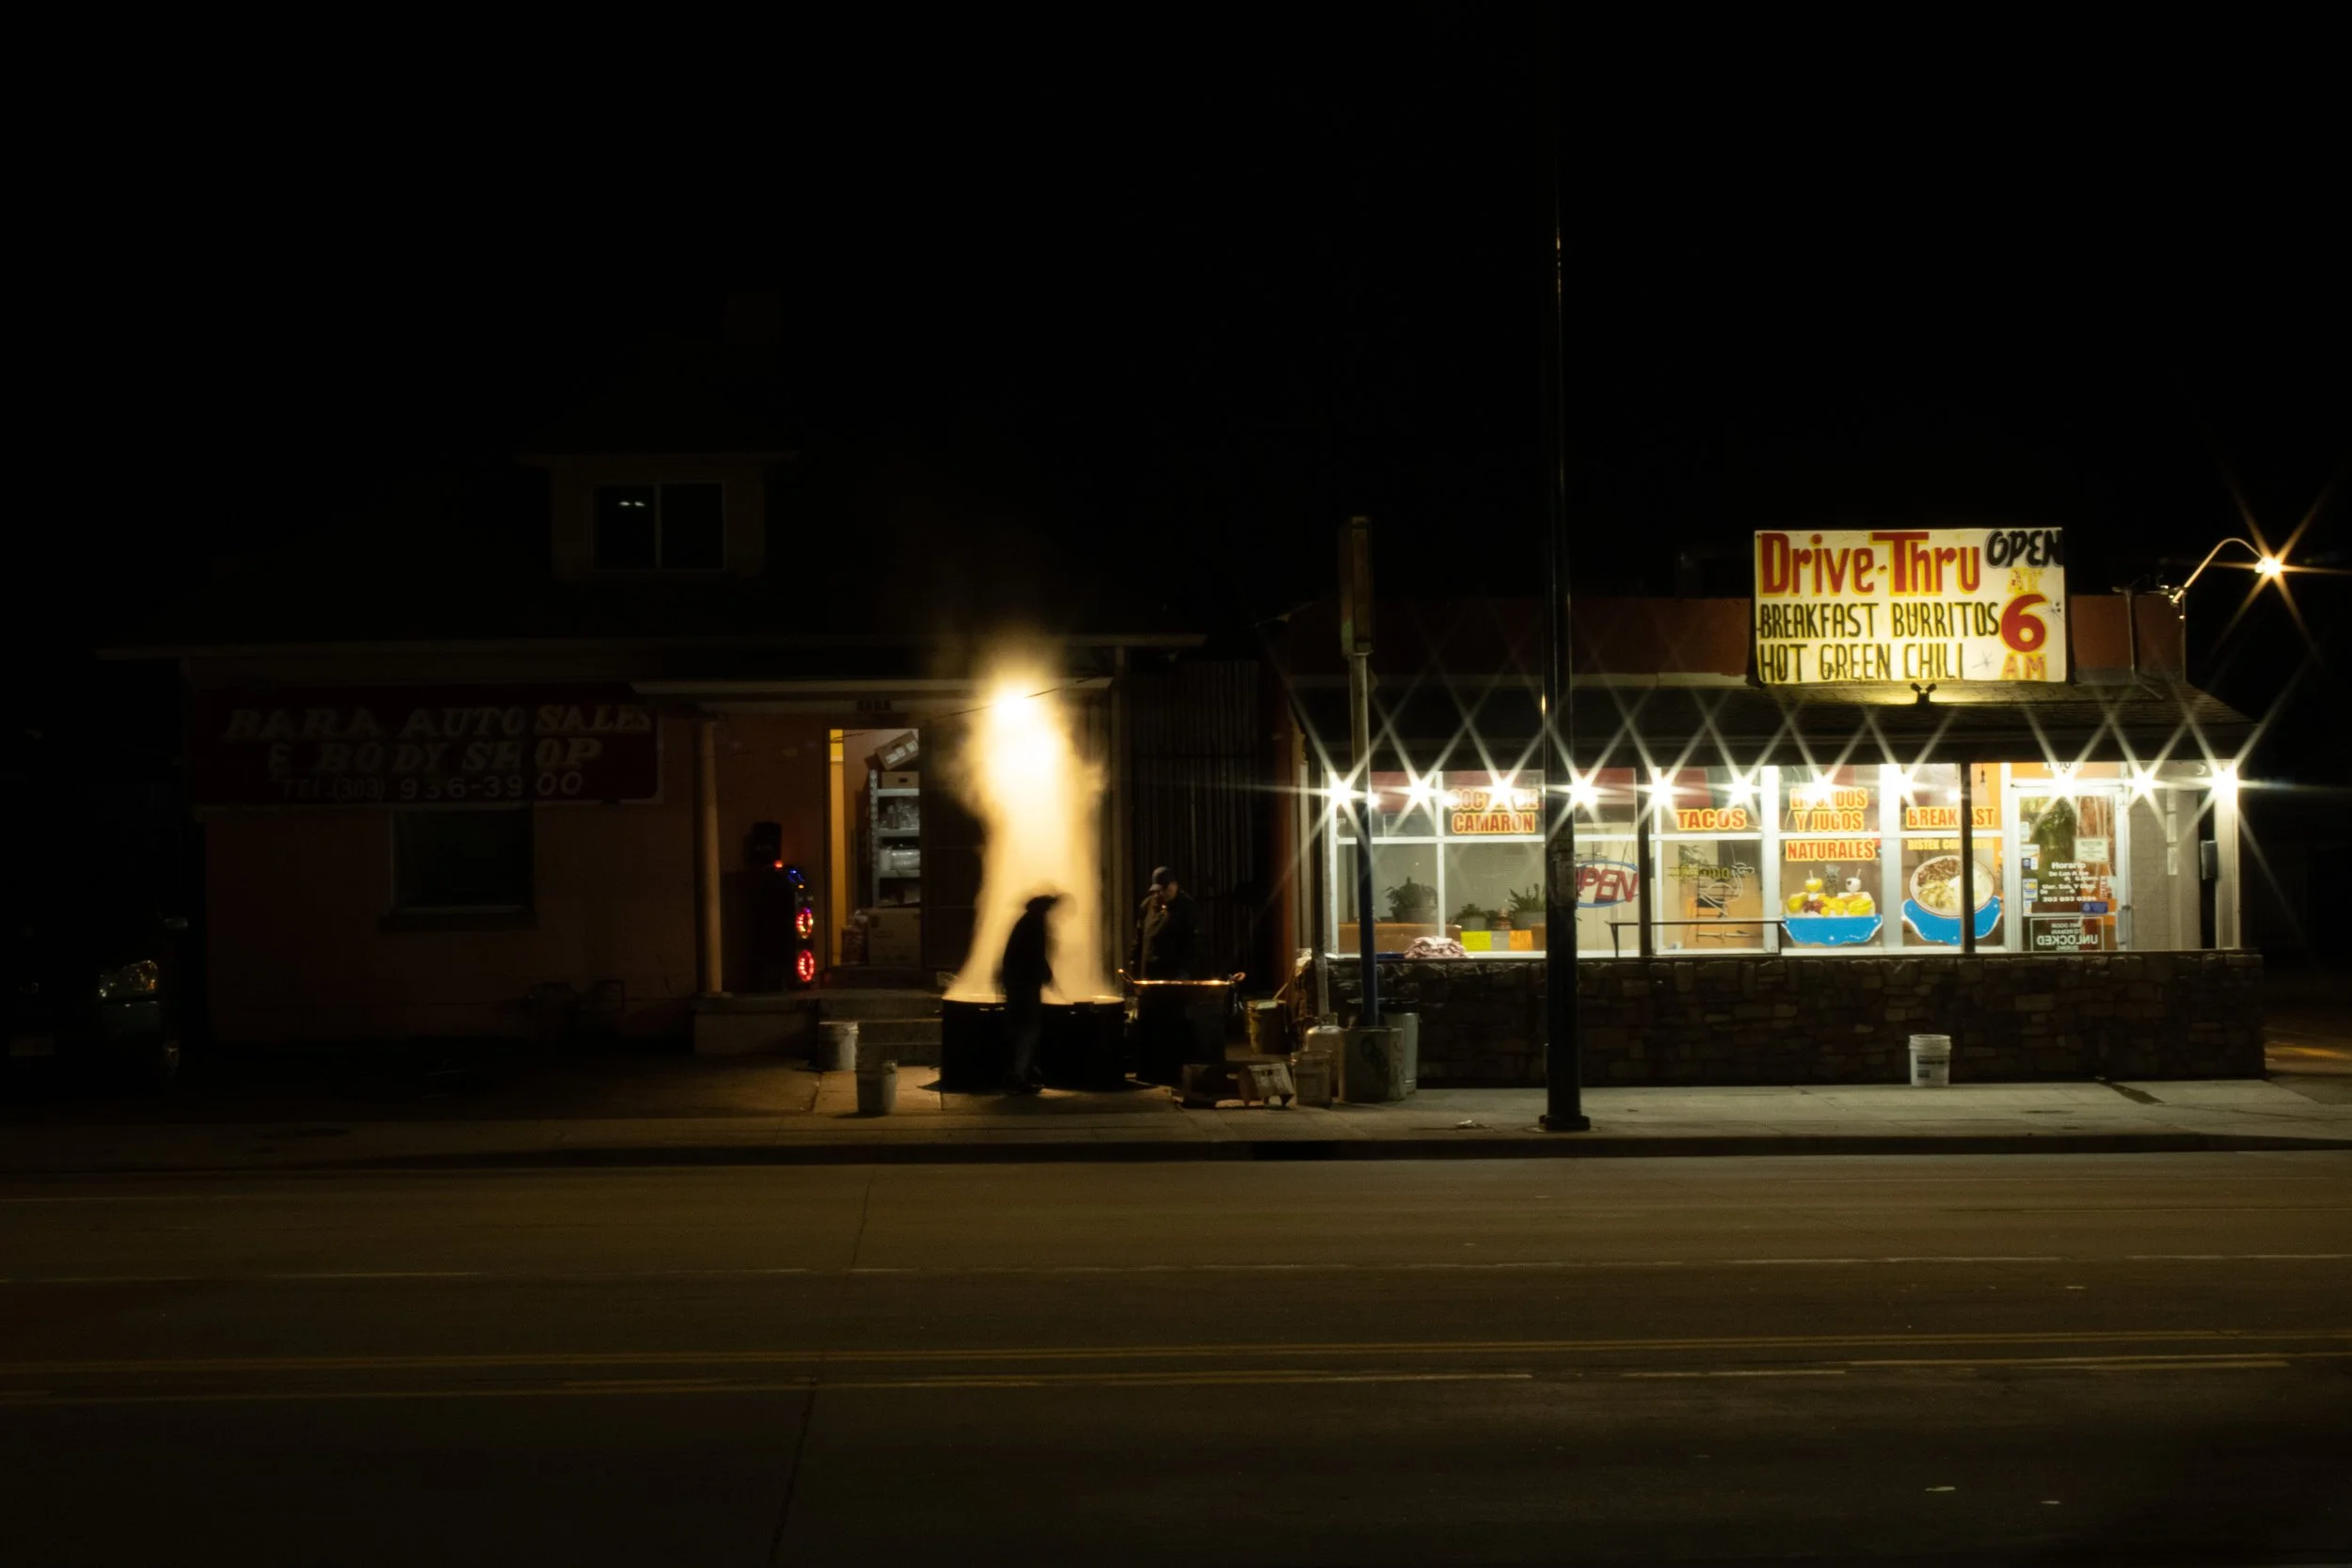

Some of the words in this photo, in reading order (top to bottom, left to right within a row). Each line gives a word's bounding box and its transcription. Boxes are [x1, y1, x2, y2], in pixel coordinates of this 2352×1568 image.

[1759, 531, 1980, 596] Drive-Thru
[1986, 529, 2065, 567] OPEN
[1760, 602, 1880, 639] BREAKFAST
[1892, 601, 1999, 638] BURRITOS
[2000, 593, 2048, 654] 6
[1759, 643, 1807, 682] HOT
[1819, 642, 1891, 680] GREEN
[1902, 642, 1965, 679] CHILI
[2000, 653, 2048, 681] AM
[397, 705, 527, 738] AUTO
[534, 704, 653, 735] SALES
[317, 741, 450, 774] BODY
[461, 737, 604, 773] SHOP
[1453, 813, 1535, 833] CAMARON
[1676, 809, 1747, 830] TACOS
[1794, 811, 1808, 832] Y
[1811, 811, 1864, 832] JUGOS
[1786, 841, 1876, 861] NATURALES
[1576, 866, 1640, 902] PEN
